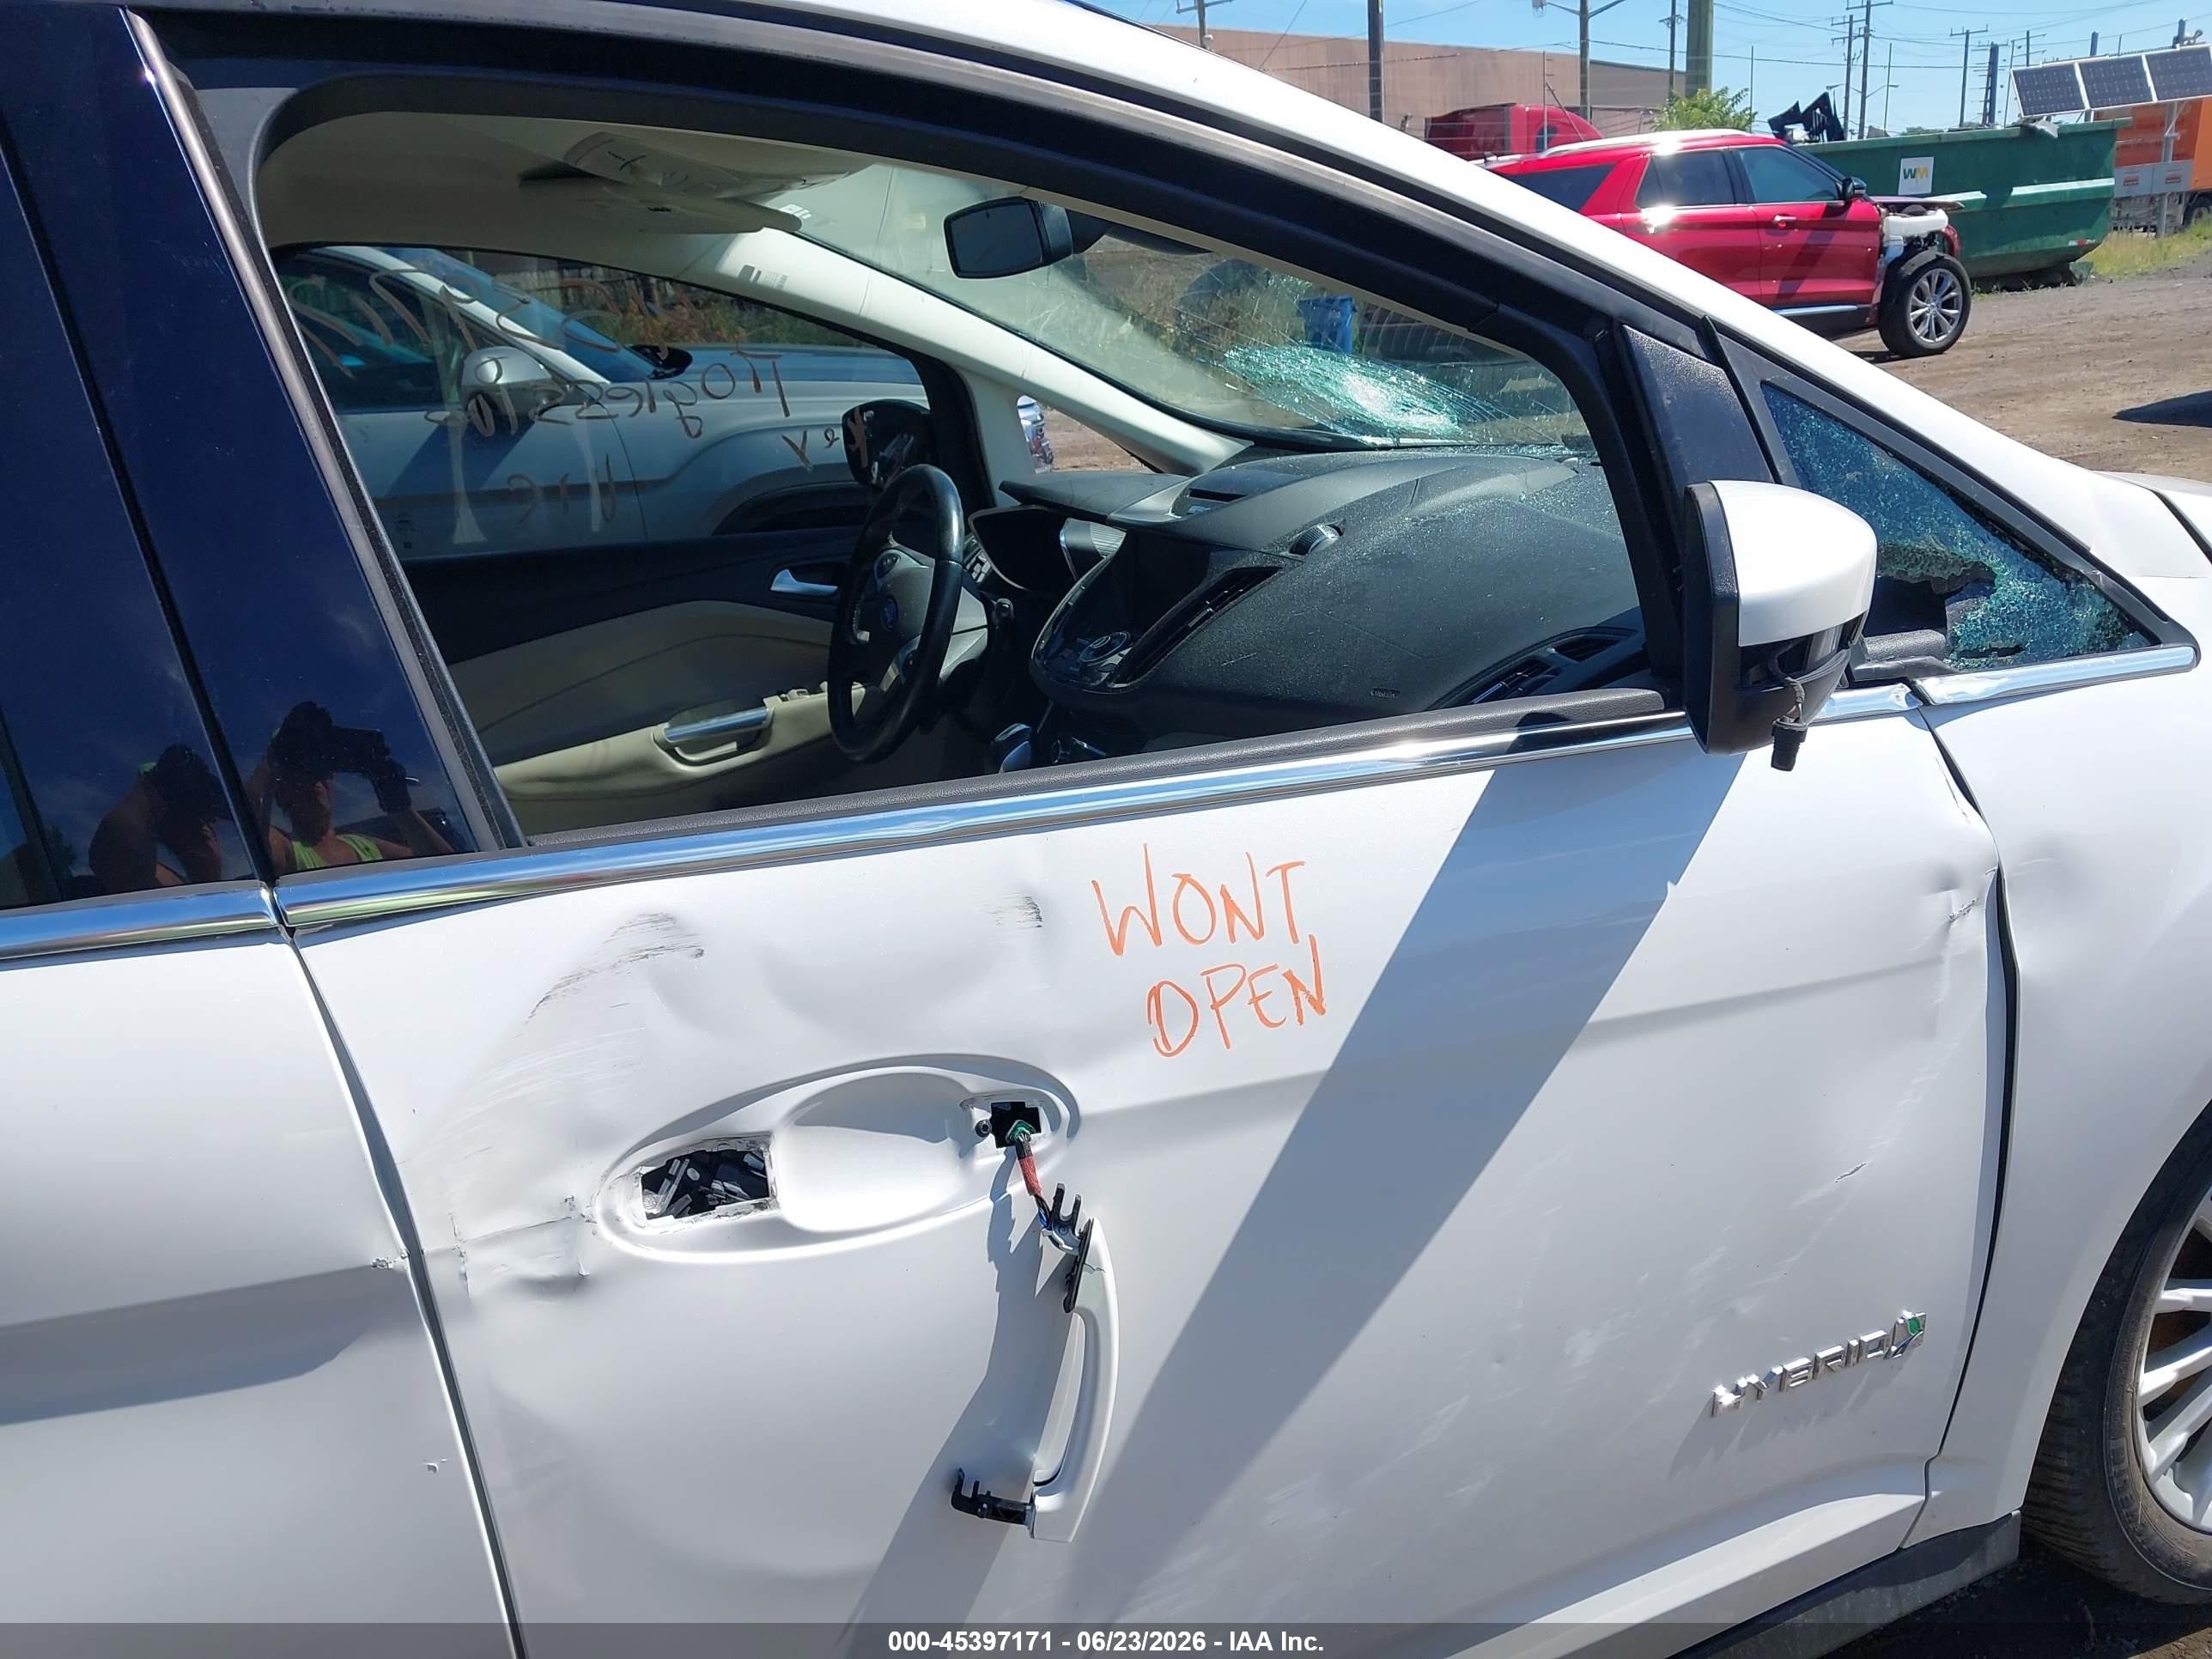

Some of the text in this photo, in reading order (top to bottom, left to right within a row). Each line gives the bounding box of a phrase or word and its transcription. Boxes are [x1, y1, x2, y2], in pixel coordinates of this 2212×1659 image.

[1903, 165, 1929, 179] WM
[1091, 842, 1305, 956] WONT
[1146, 933, 1327, 1057] OPEN
[1711, 1328, 1888, 1418] HYBRID
